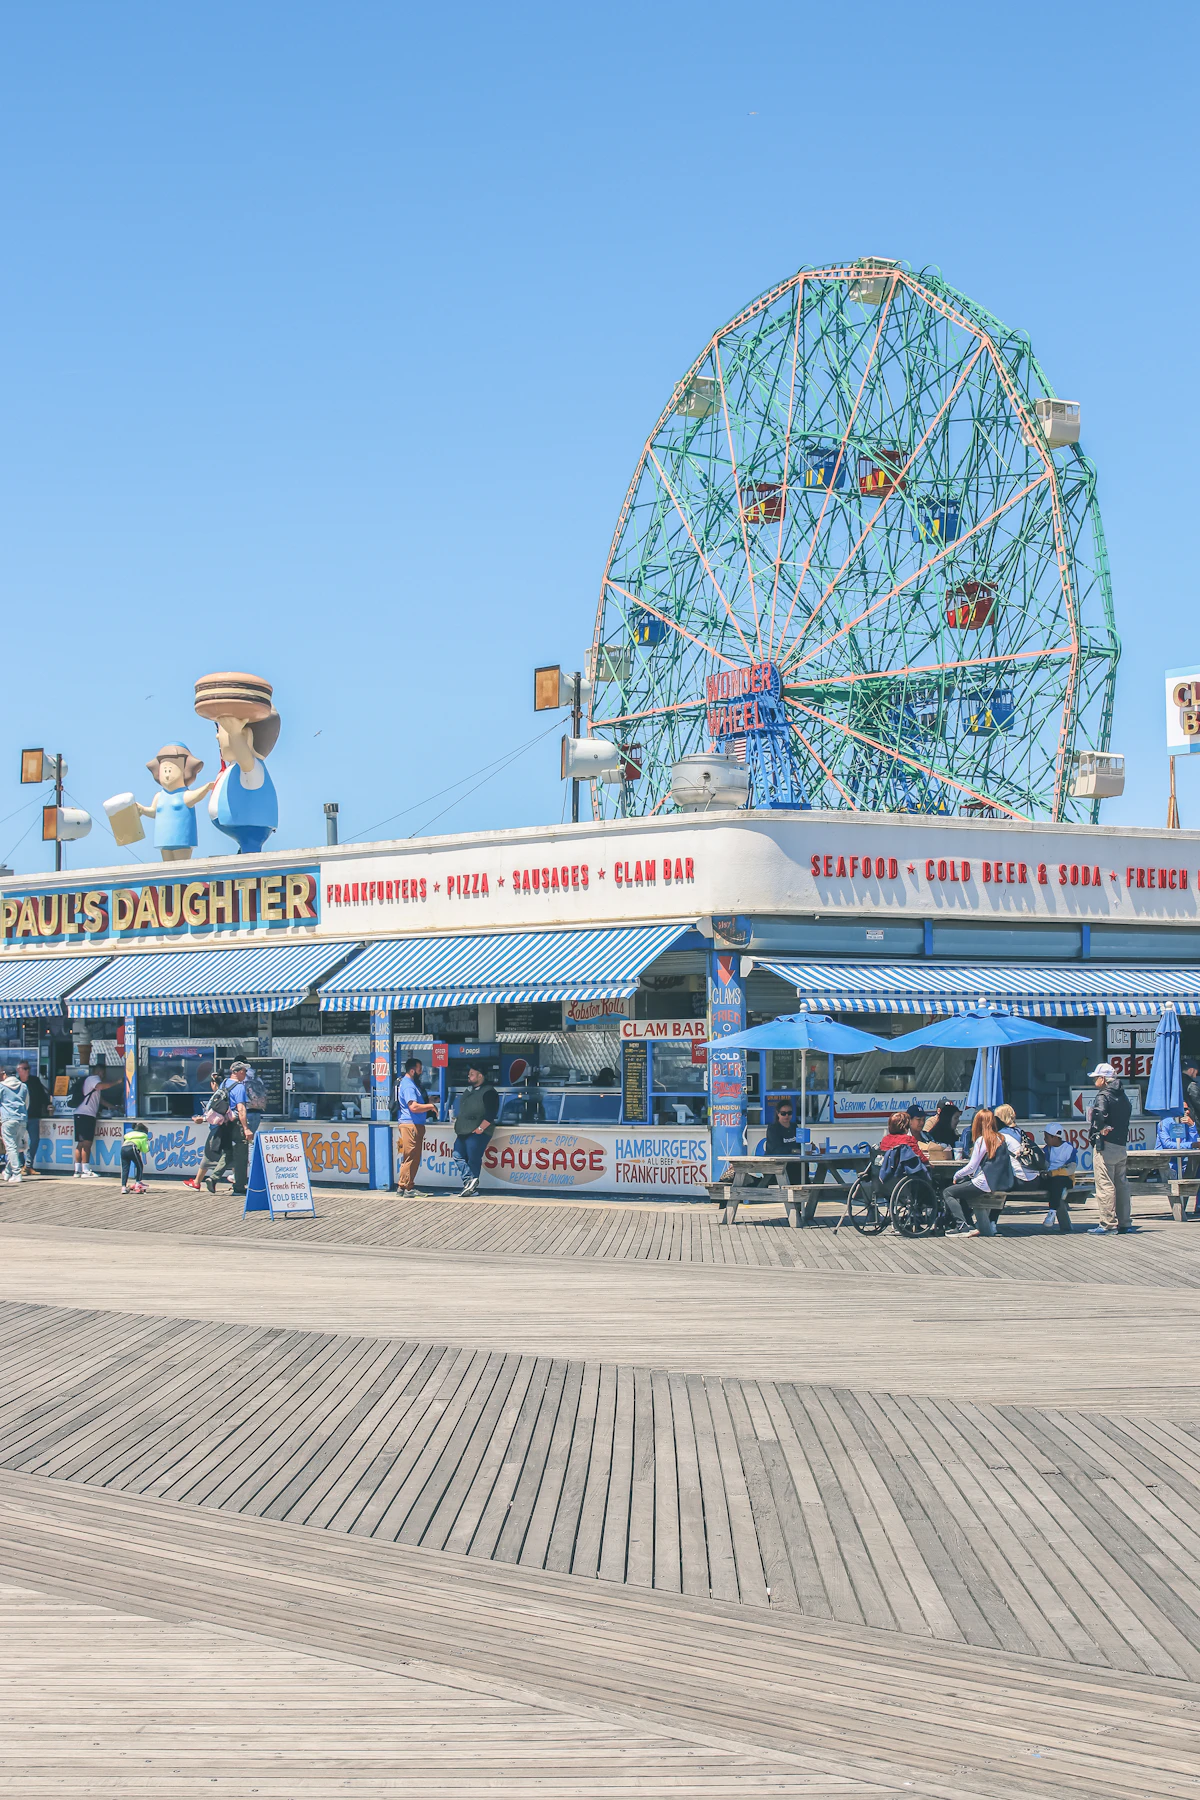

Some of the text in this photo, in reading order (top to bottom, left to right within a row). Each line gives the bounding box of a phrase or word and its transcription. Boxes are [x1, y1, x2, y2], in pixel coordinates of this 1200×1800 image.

[706, 662, 772, 704] WONDER
[706, 701, 764, 736] WHEEL
[810, 853, 1188, 890] SEAFOOD COLD BEER & SODA FRENCH
[327, 857, 695, 904] FRANKFURTERS PIZZA SAUSAGES CLAM BAR
[1, 873, 316, 938] PAUL'S DAUGHTER
[712, 987, 741, 1005] CLAMS
[567, 1000, 600, 1022] Lobster
[601, 997, 624, 1016] Rolls
[712, 1010, 741, 1026] FRIED
[370, 1022, 390, 1036] CLAMS
[623, 1022, 668, 1037] CLAM
[672, 1022, 705, 1037] BAR
[1110, 1028, 1129, 1044] ICE
[317, 1045, 345, 1053] ORDER HERE
[371, 1040, 390, 1053] FRIES
[370, 1062, 390, 1076] PIZZA
[712, 1062, 742, 1077] BEER
[286, 1076, 292, 1087] 2
[840, 1097, 867, 1112] SERVING
[869, 1096, 889, 1111] CONEY
[712, 1112, 742, 1127] FRIES
[58, 1125, 74, 1136] TAFF
[264, 1135, 299, 1144] SAUSAGE
[509, 1134, 536, 1145] SWEET
[554, 1136, 579, 1147] SPICY
[265, 1152, 302, 1163] Clam Bar
[302, 1131, 369, 1174] Knish
[615, 1139, 707, 1161] HAMBURGERS
[484, 1146, 604, 1172] SAUSAGE
[509, 1171, 541, 1183] PEPPERS
[548, 1173, 575, 1185] ONIONS
[615, 1163, 708, 1185] FRANKFURTERS
[270, 1181, 306, 1190] French Fries
[272, 1192, 309, 1201] COLD BEER
